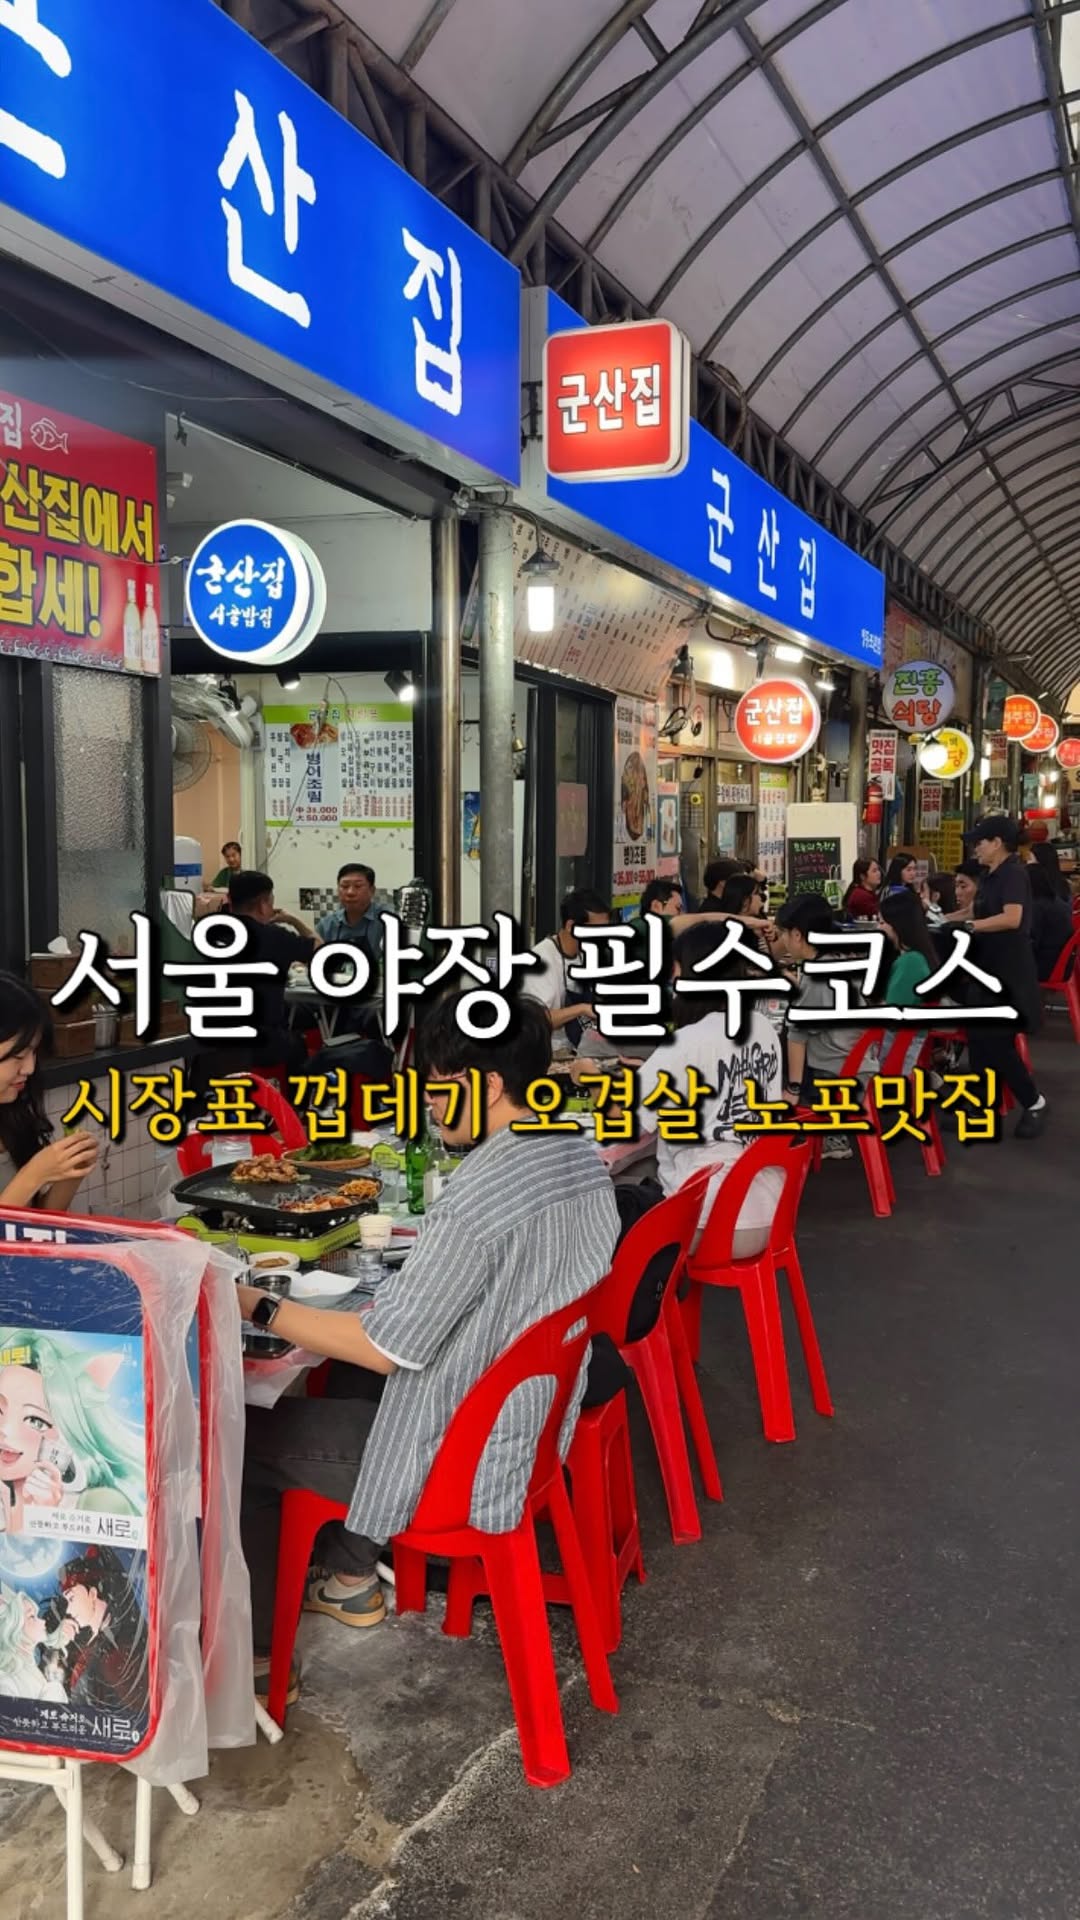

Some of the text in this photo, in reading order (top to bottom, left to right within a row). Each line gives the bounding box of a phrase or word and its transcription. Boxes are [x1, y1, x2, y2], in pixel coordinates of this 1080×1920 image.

[557, 363, 661, 435] 군산집
[706, 467, 816, 620] 군산집
[196, 554, 287, 599] 군산집
[208, 603, 273, 629] 시골밥집
[745, 697, 803, 726] 군산집
[892, 698, 943, 727] 식당
[97, 1517, 131, 1539] 새로
[92, 1716, 131, 1741] 새로
